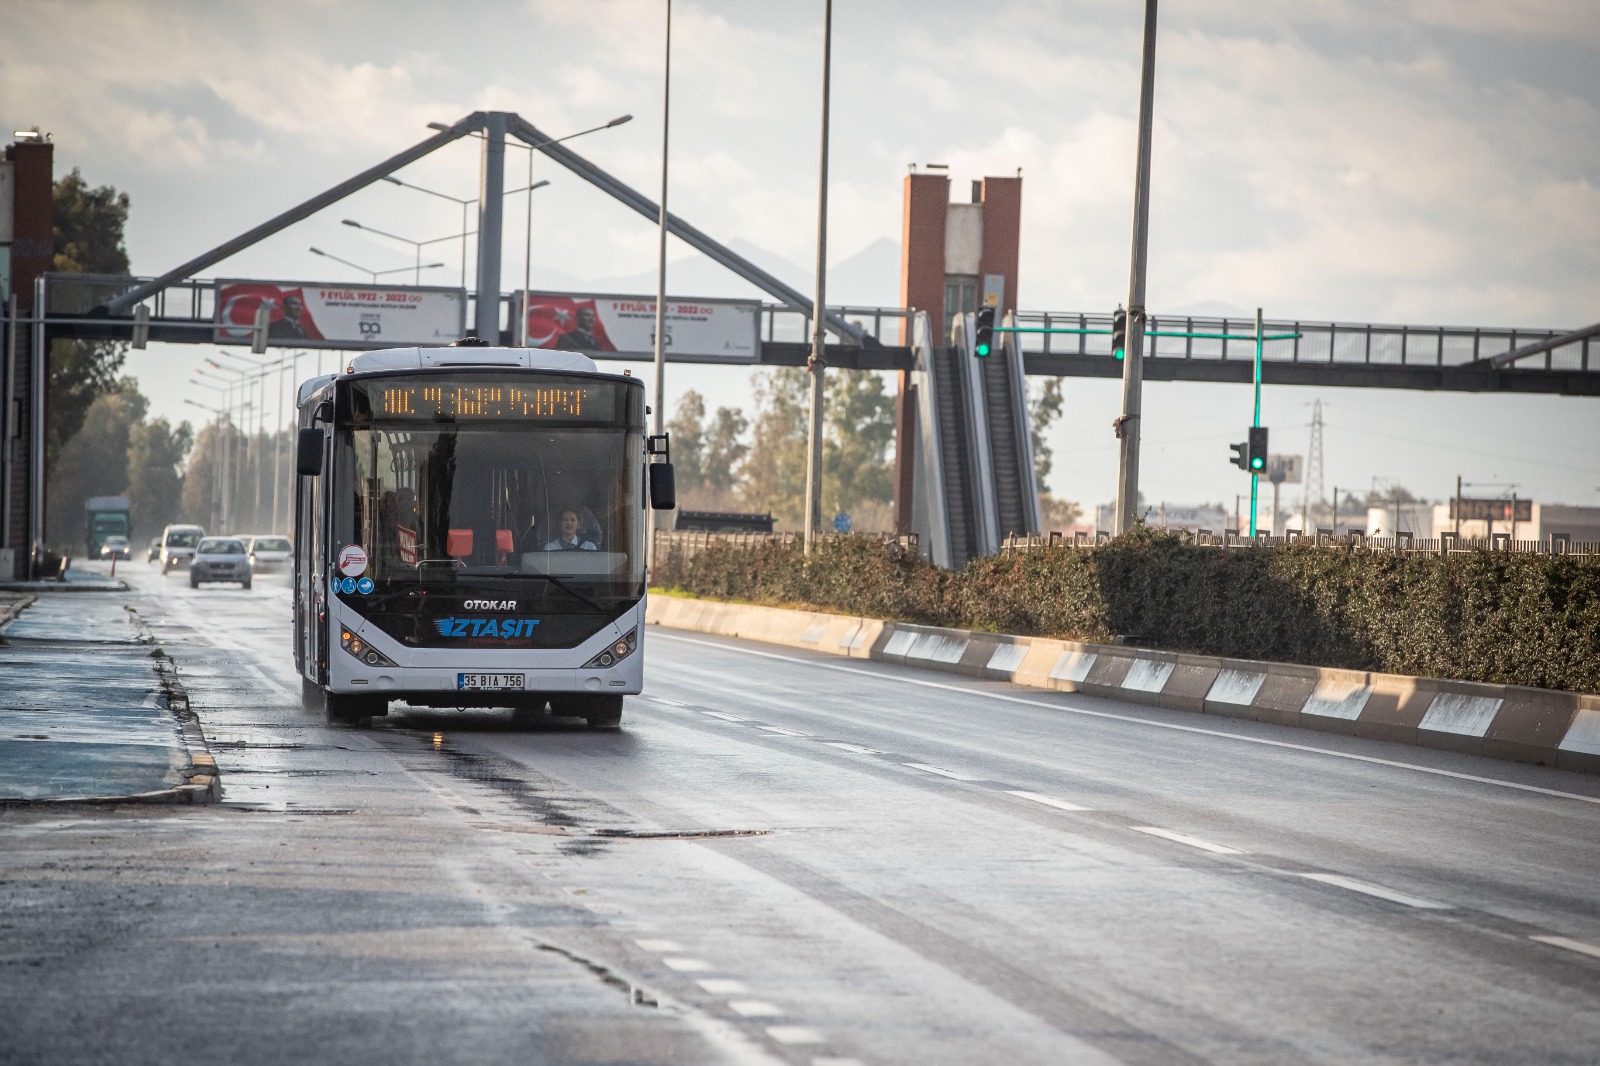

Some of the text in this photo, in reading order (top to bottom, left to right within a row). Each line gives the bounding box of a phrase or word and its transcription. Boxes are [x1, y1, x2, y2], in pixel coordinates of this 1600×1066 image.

[320, 290, 326, 299] 9
[327, 289, 355, 300] EYLÜL
[358, 292, 376, 301] 1922
[386, 294, 407, 303] 2022
[612, 302, 618, 310] 9
[620, 301, 647, 312] EYLÜL
[677, 305, 698, 314] 2022
[463, 600, 517, 611] OTOKAR
[432, 616, 541, 639] İZTAŞIT
[464, 675, 522, 687] 35 BIA 756
